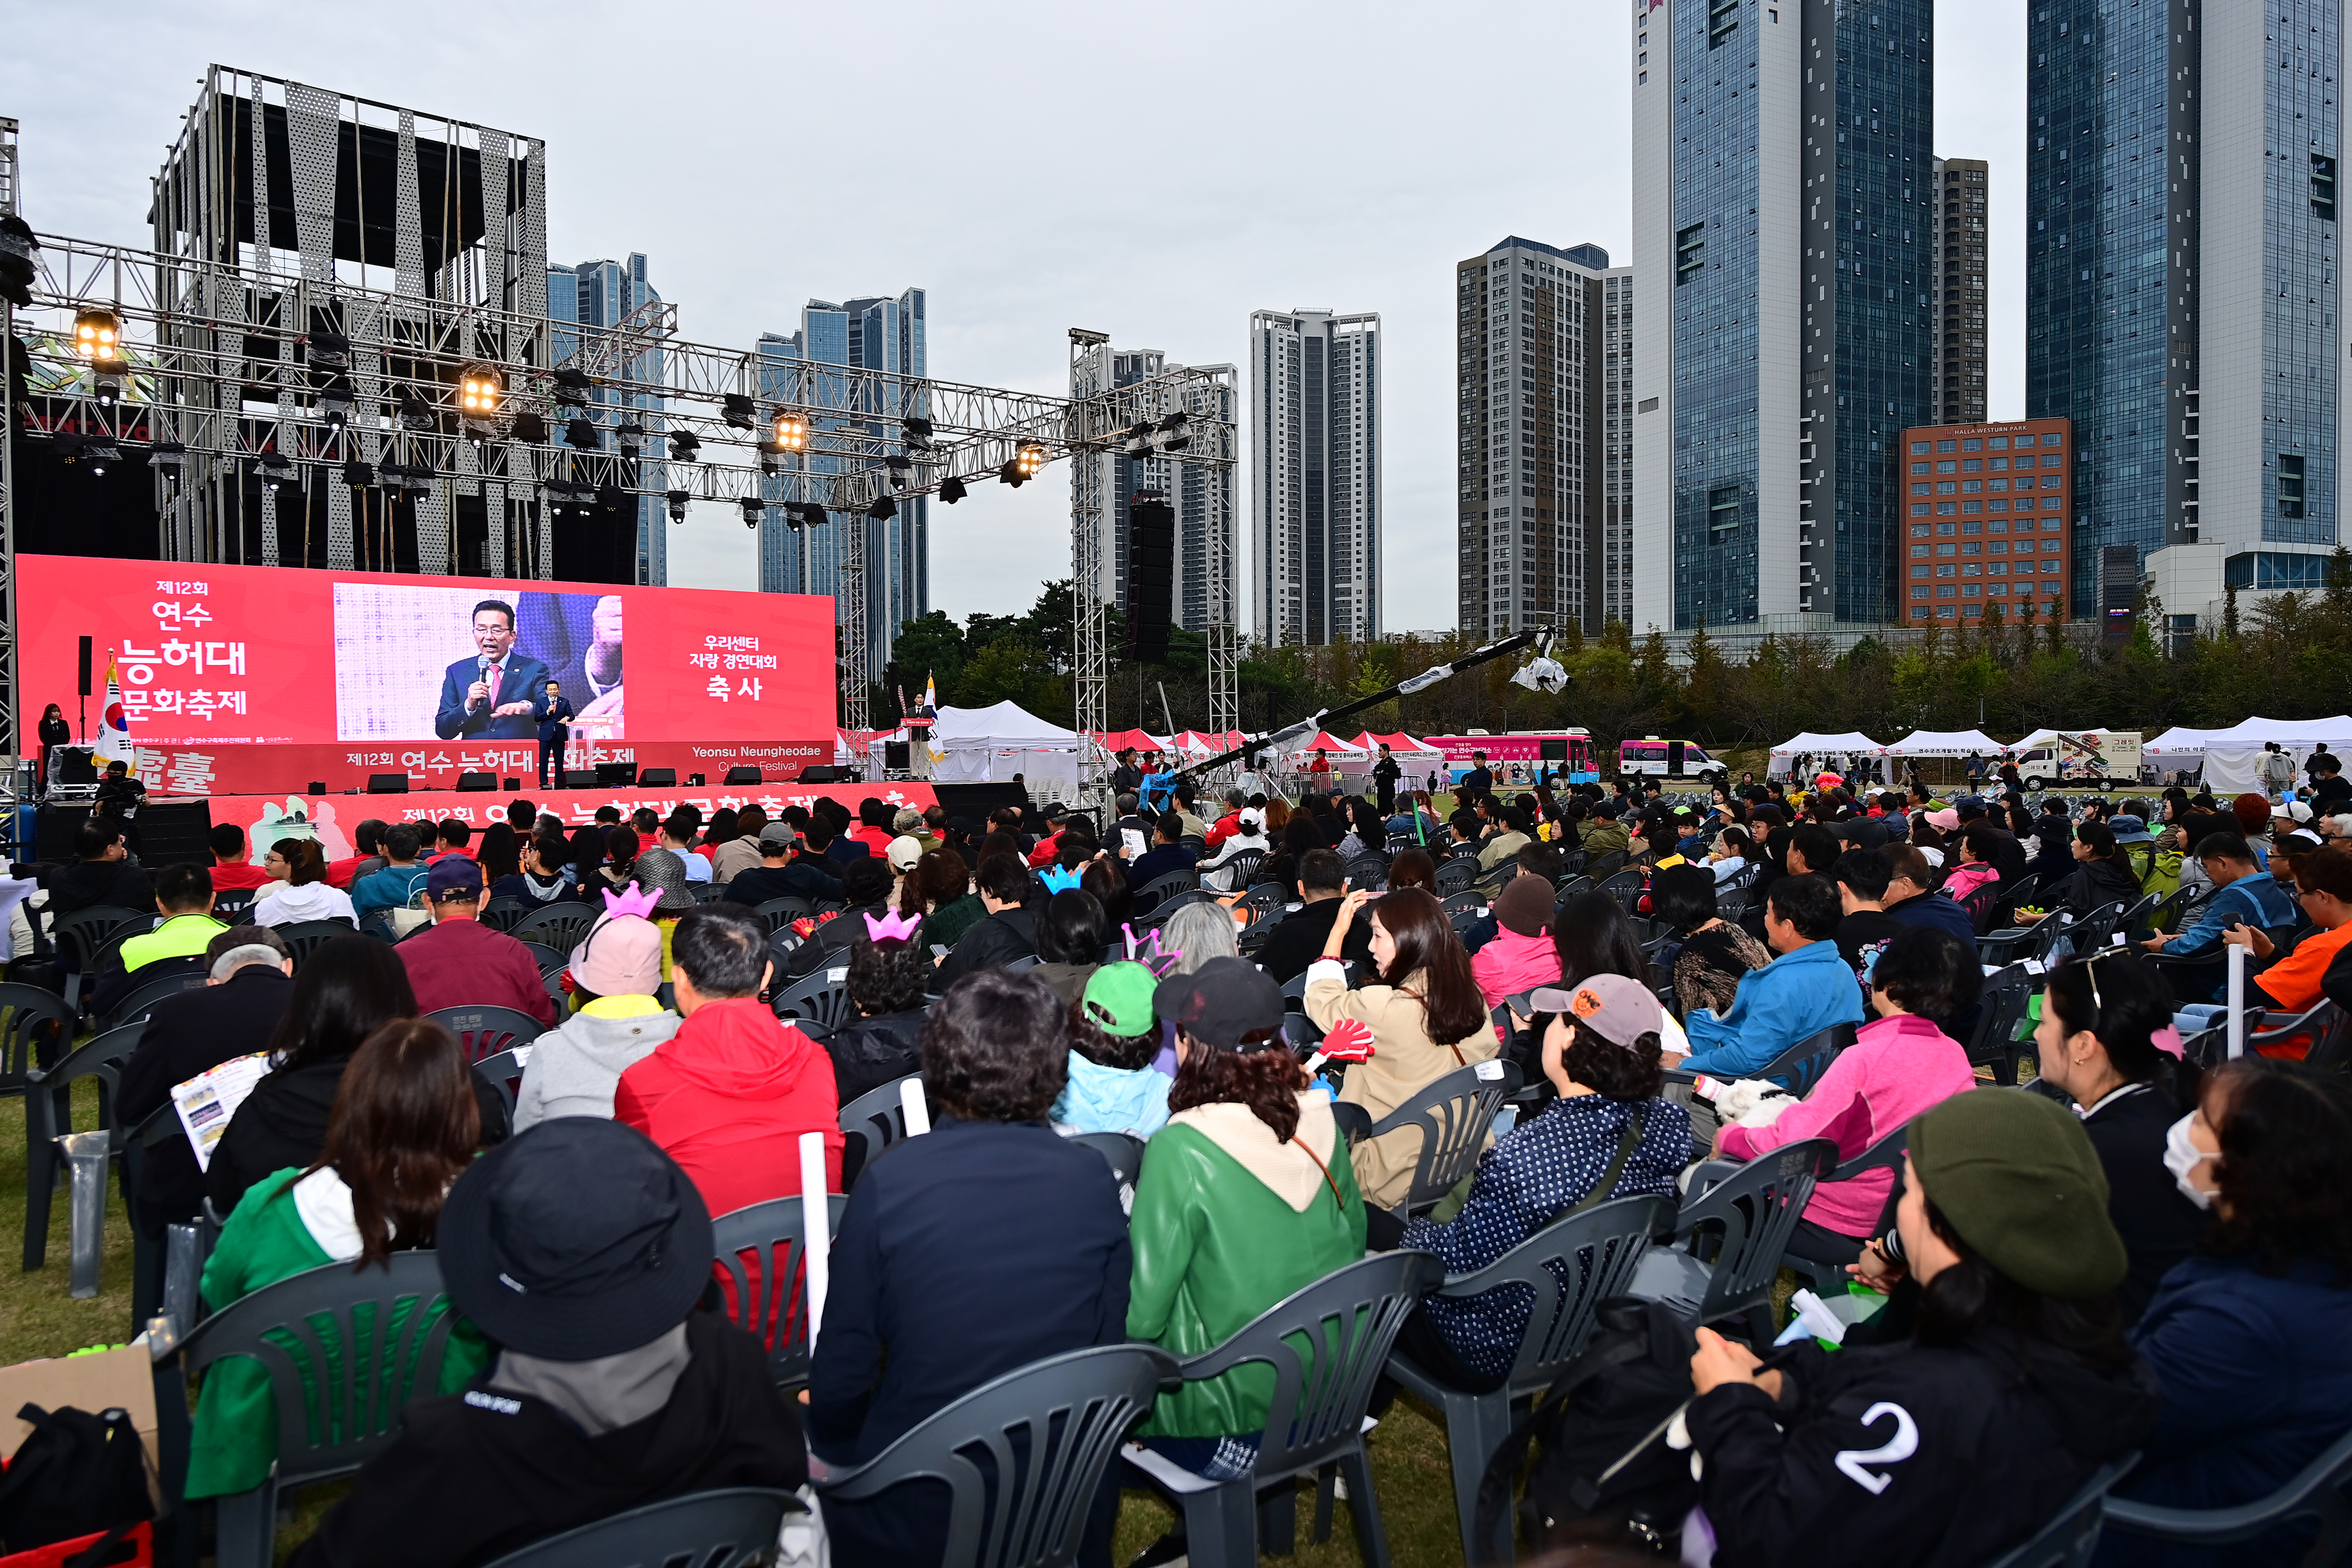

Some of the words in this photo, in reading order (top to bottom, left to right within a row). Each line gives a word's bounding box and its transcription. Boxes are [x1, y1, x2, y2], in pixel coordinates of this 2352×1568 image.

[156, 581, 208, 595] 제12회
[152, 602, 212, 631] 연수
[704, 635, 758, 651] 우리센터
[117, 638, 245, 685] 능허대
[689, 653, 720, 669] 자랑
[723, 654, 777, 670] 경연대회
[122, 688, 247, 721] 문화축제
[693, 747, 736, 757] Yeonsu
[741, 746, 821, 757] Neungheodae
[347, 752, 394, 766] 제12회
[401, 751, 454, 779] 연수
[457, 749, 533, 774] 능허대
[759, 761, 797, 771] Festival
[1835, 1402, 1919, 1495] 2
